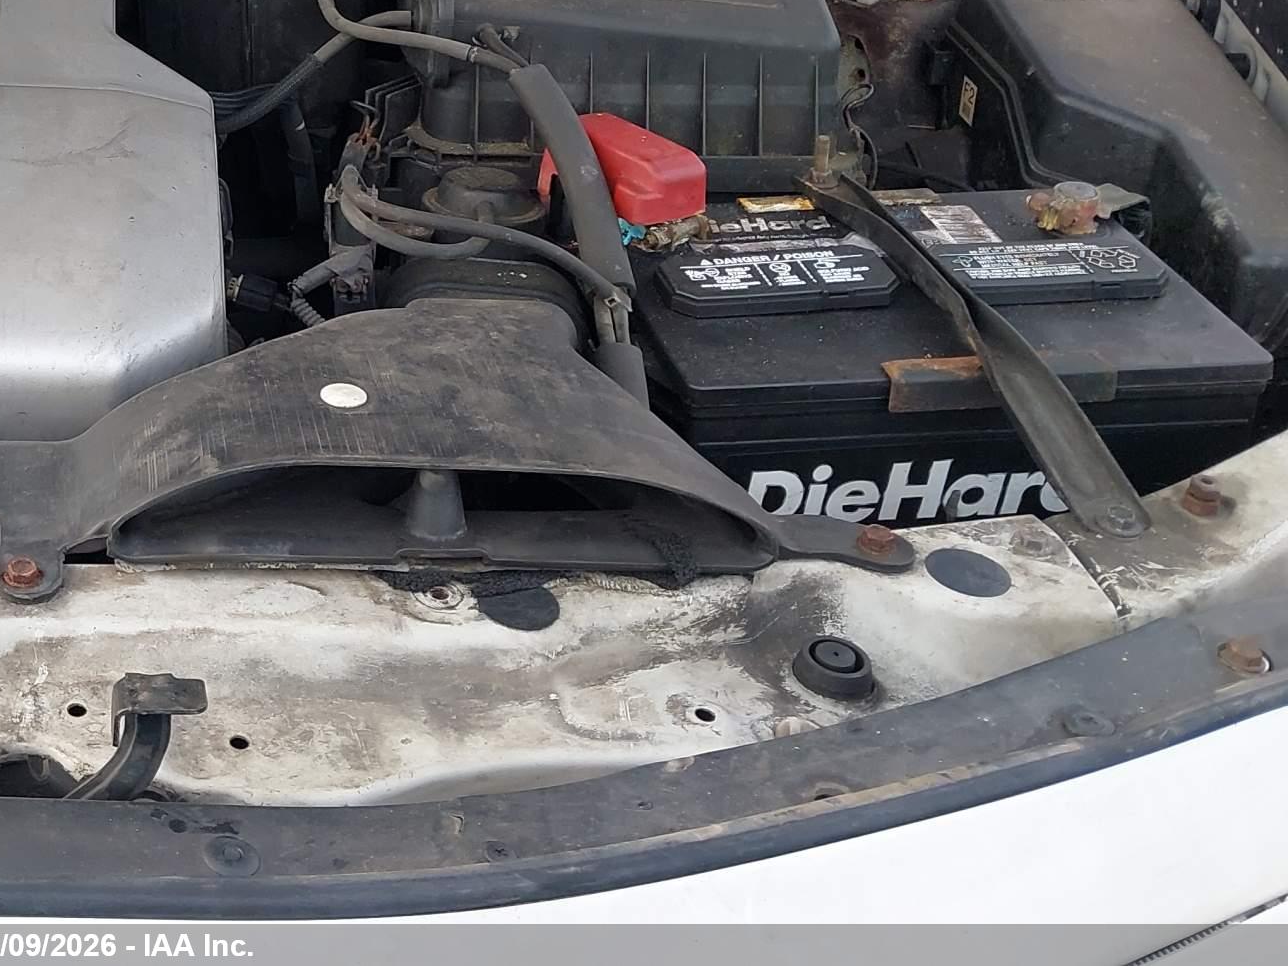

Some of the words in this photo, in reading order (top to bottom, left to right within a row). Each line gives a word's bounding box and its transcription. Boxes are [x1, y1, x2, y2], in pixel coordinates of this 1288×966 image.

[708, 215, 832, 234] ieHard
[713, 255, 771, 266] DANGER
[783, 250, 836, 261] POISON
